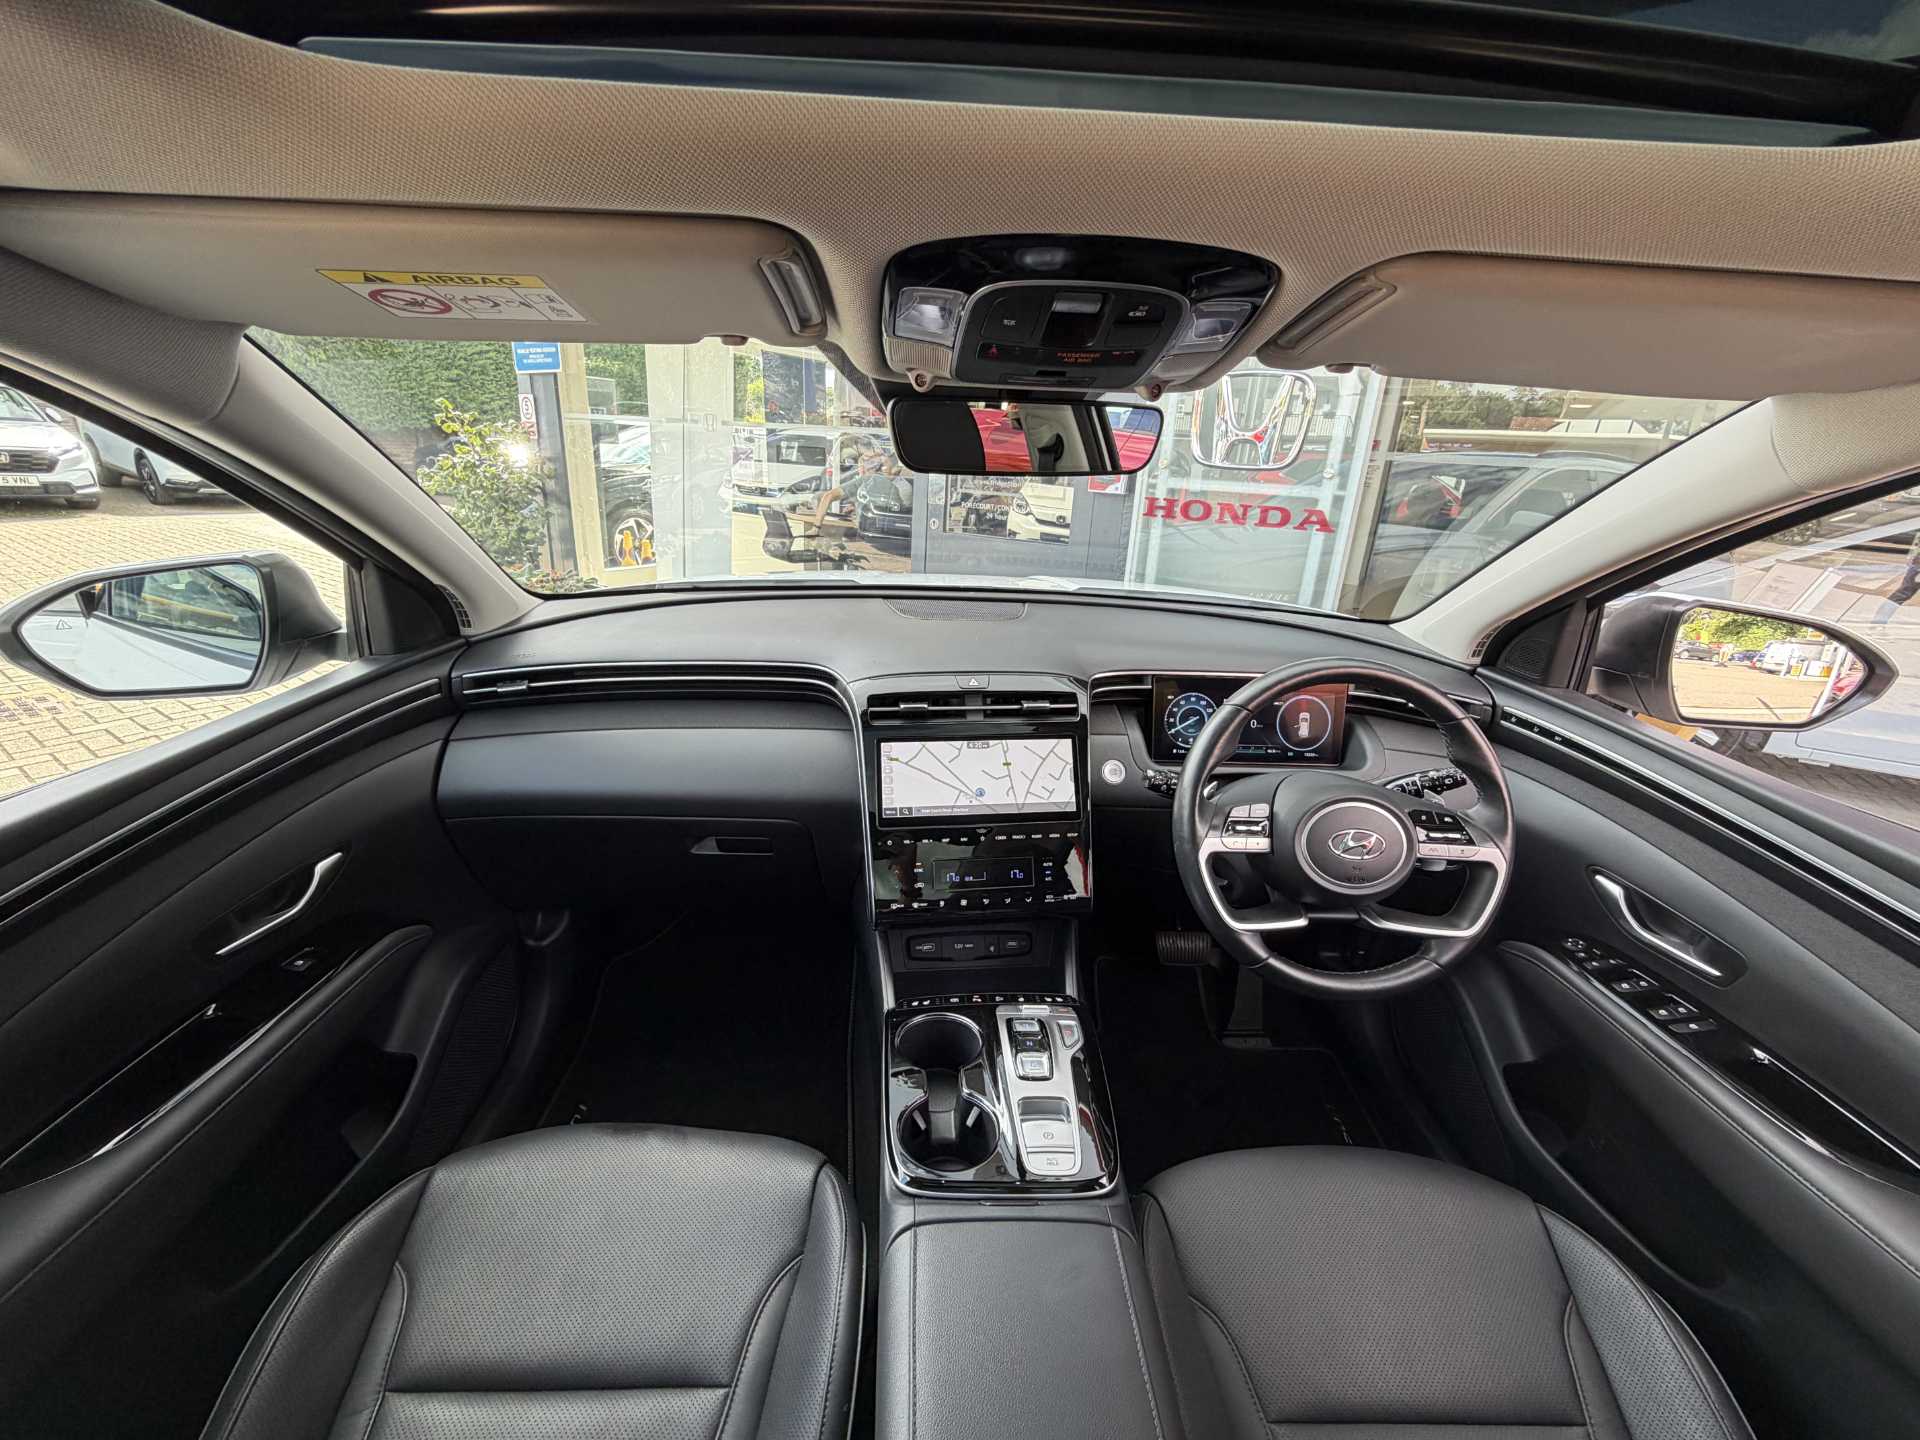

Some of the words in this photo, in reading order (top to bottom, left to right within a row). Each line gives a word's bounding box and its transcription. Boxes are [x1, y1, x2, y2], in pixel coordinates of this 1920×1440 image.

[411, 274, 521, 287] AIRBAG
[11, 476, 35, 485] VNL
[1142, 496, 1336, 534] HONDA
[1250, 719, 1257, 729] 0
